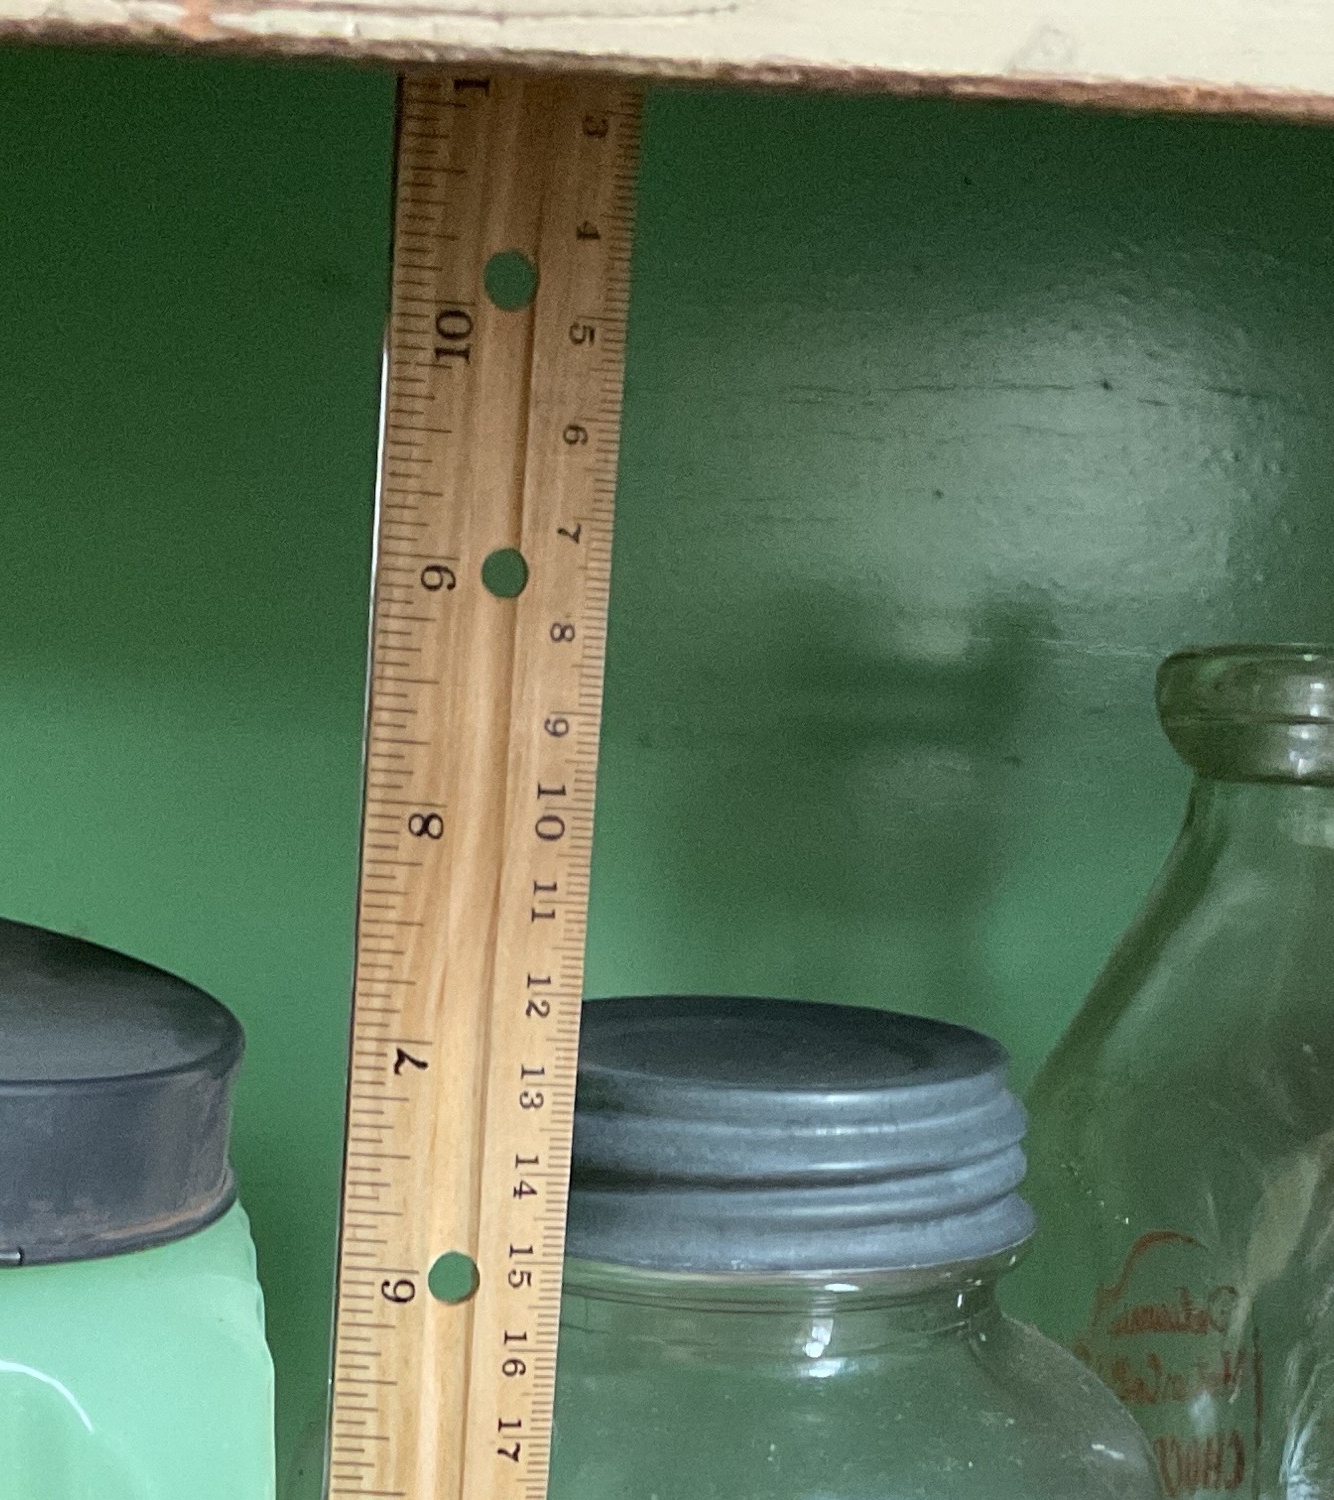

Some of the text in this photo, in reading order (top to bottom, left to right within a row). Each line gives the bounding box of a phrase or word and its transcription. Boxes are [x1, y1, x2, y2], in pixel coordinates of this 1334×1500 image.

[581, 115, 609, 138] 3
[575, 221, 602, 242] 4
[434, 308, 474, 364] 10
[568, 322, 596, 347] 5
[562, 424, 589, 446] 6
[556, 522, 582, 544] 7
[419, 563, 458, 593] 9
[548, 621, 577, 644] 8
[543, 716, 570, 739] 9
[407, 811, 445, 841] 8
[533, 782, 567, 843] 10
[529, 879, 559, 924] 11
[525, 972, 553, 1019] 12
[393, 1048, 430, 1077] 7
[518, 1063, 546, 1111] 13
[512, 1153, 541, 1200] 14
[507, 1243, 535, 1288] 15
[380, 1277, 417, 1305] 6
[500, 1329, 528, 1379] 16
[496, 1417, 523, 1464] 17
